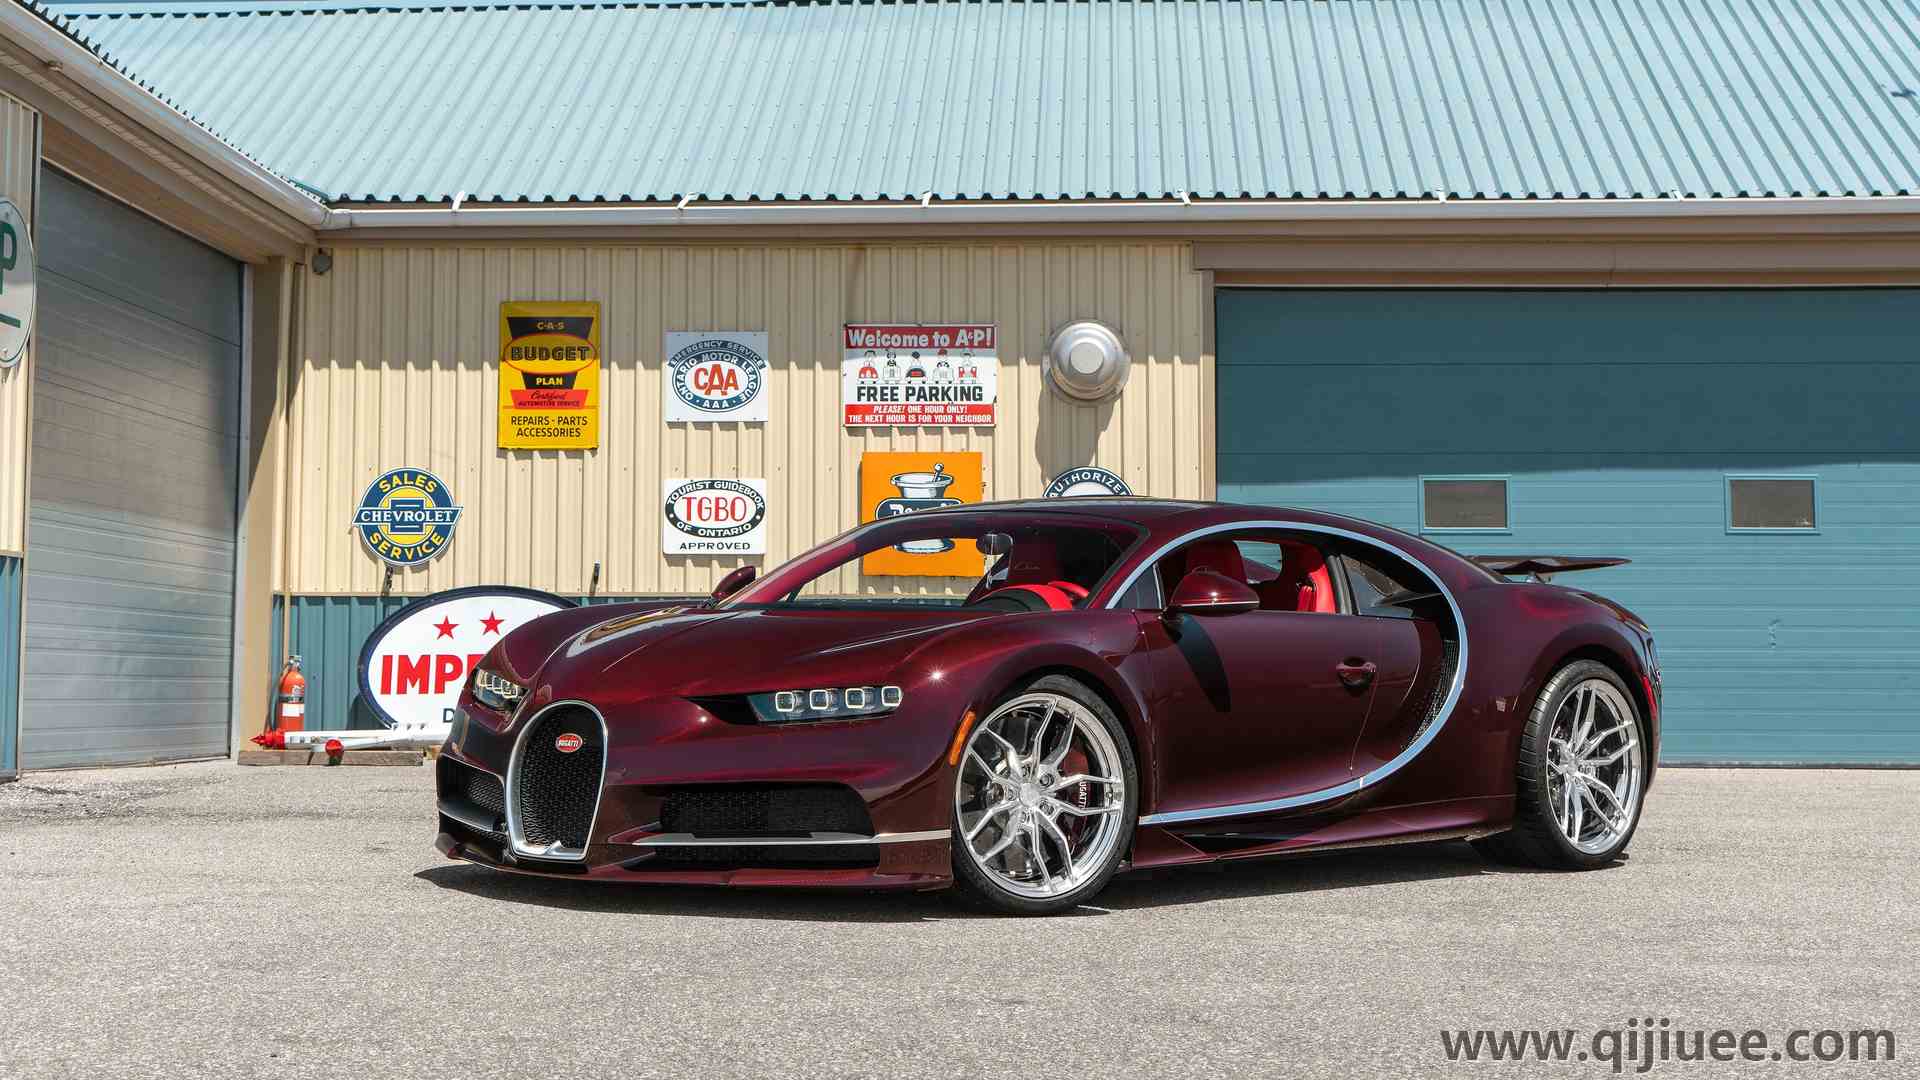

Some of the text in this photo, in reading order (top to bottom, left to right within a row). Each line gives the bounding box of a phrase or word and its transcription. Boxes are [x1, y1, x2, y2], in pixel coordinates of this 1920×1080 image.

[848, 328, 929, 348] Welcome
[933, 331, 949, 348] to
[511, 346, 589, 361] BUDGET
[670, 341, 764, 367] EMERGENCY SERVICE
[536, 377, 563, 385] PLAN
[677, 352, 757, 402] ONTARIO MOTOR LEAGUE
[694, 364, 739, 396] CAA
[856, 386, 984, 402] FREE PARKING
[702, 400, 729, 409] AAA
[873, 405, 968, 414] PLEASE! ONE HOUR ONLY!
[511, 415, 588, 425] REPAIRS PARTS
[848, 415, 863, 423] THE
[865, 415, 883, 423] NEXT
[886, 415, 906, 423] HOUR
[908, 415, 917, 423] IS
[918, 415, 932, 423] FOR
[934, 415, 953, 423] YOUR
[516, 427, 581, 437] ACCESSORIES
[379, 473, 437, 493] SALES
[667, 481, 764, 509] TOURIST GUIDEBOOK
[360, 510, 453, 522] CHEVROLET
[682, 496, 747, 522] TGBO
[676, 521, 752, 537] OF ONTARIO
[370, 532, 445, 560] SERVICE
[679, 542, 751, 550] APPROVED
